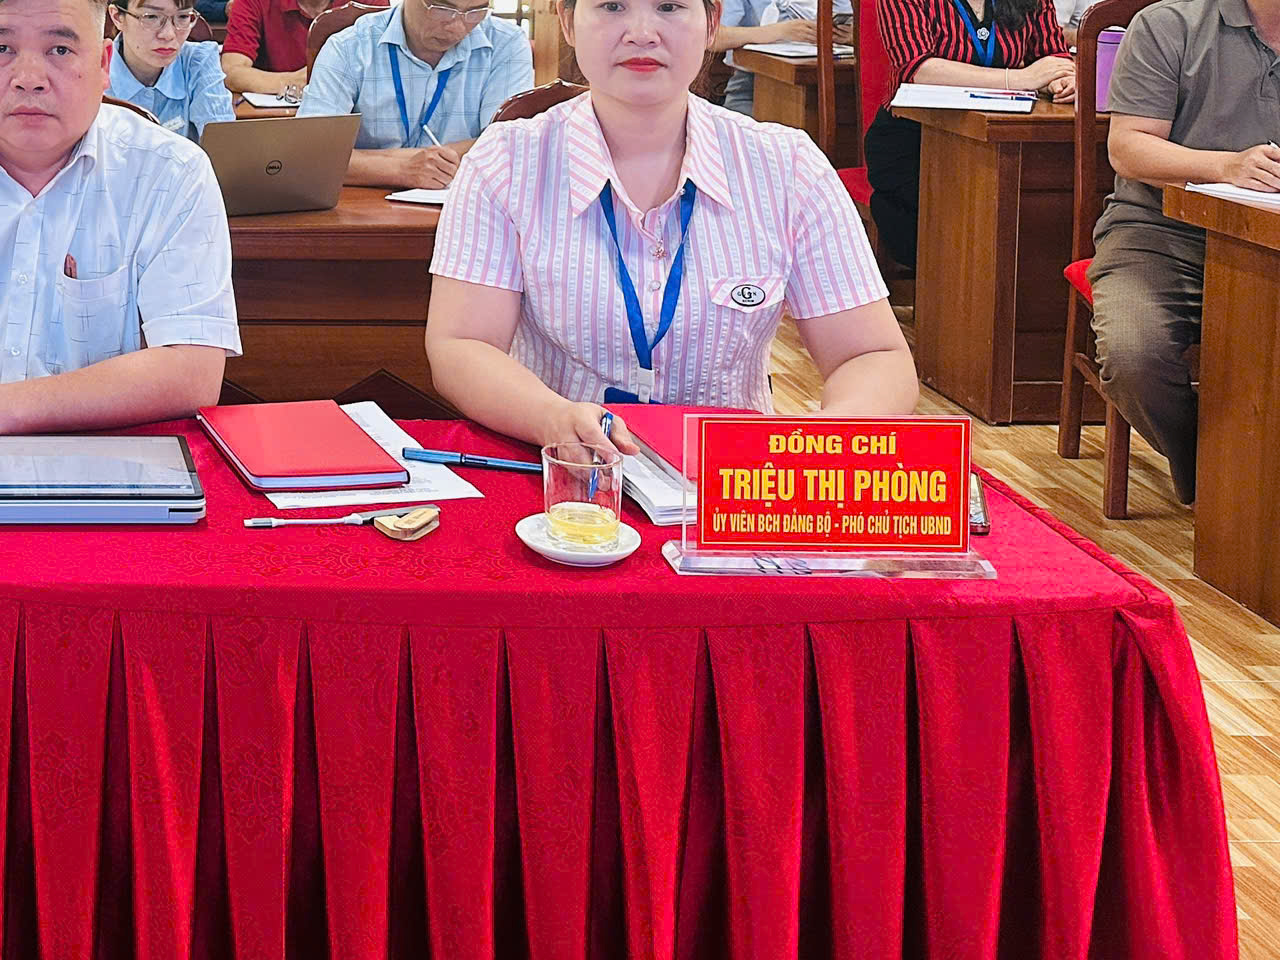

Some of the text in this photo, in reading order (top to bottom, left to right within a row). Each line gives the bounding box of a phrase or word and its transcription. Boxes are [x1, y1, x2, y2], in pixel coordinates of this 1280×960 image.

[768, 428, 896, 455] ĐỒNG CHÍ
[718, 462, 947, 509] TRIỆU THỊ PHÒNG
[712, 507, 727, 532] ỦY
[730, 509, 755, 532] VIÊN
[757, 513, 780, 533] BCH
[782, 508, 814, 533] ĐẢNG
[816, 511, 832, 538] BỘ
[842, 512, 864, 534] PHÓ
[867, 509, 890, 534] CHỦ
[893, 515, 918, 539] TỊCH
[920, 515, 952, 535] UBND
